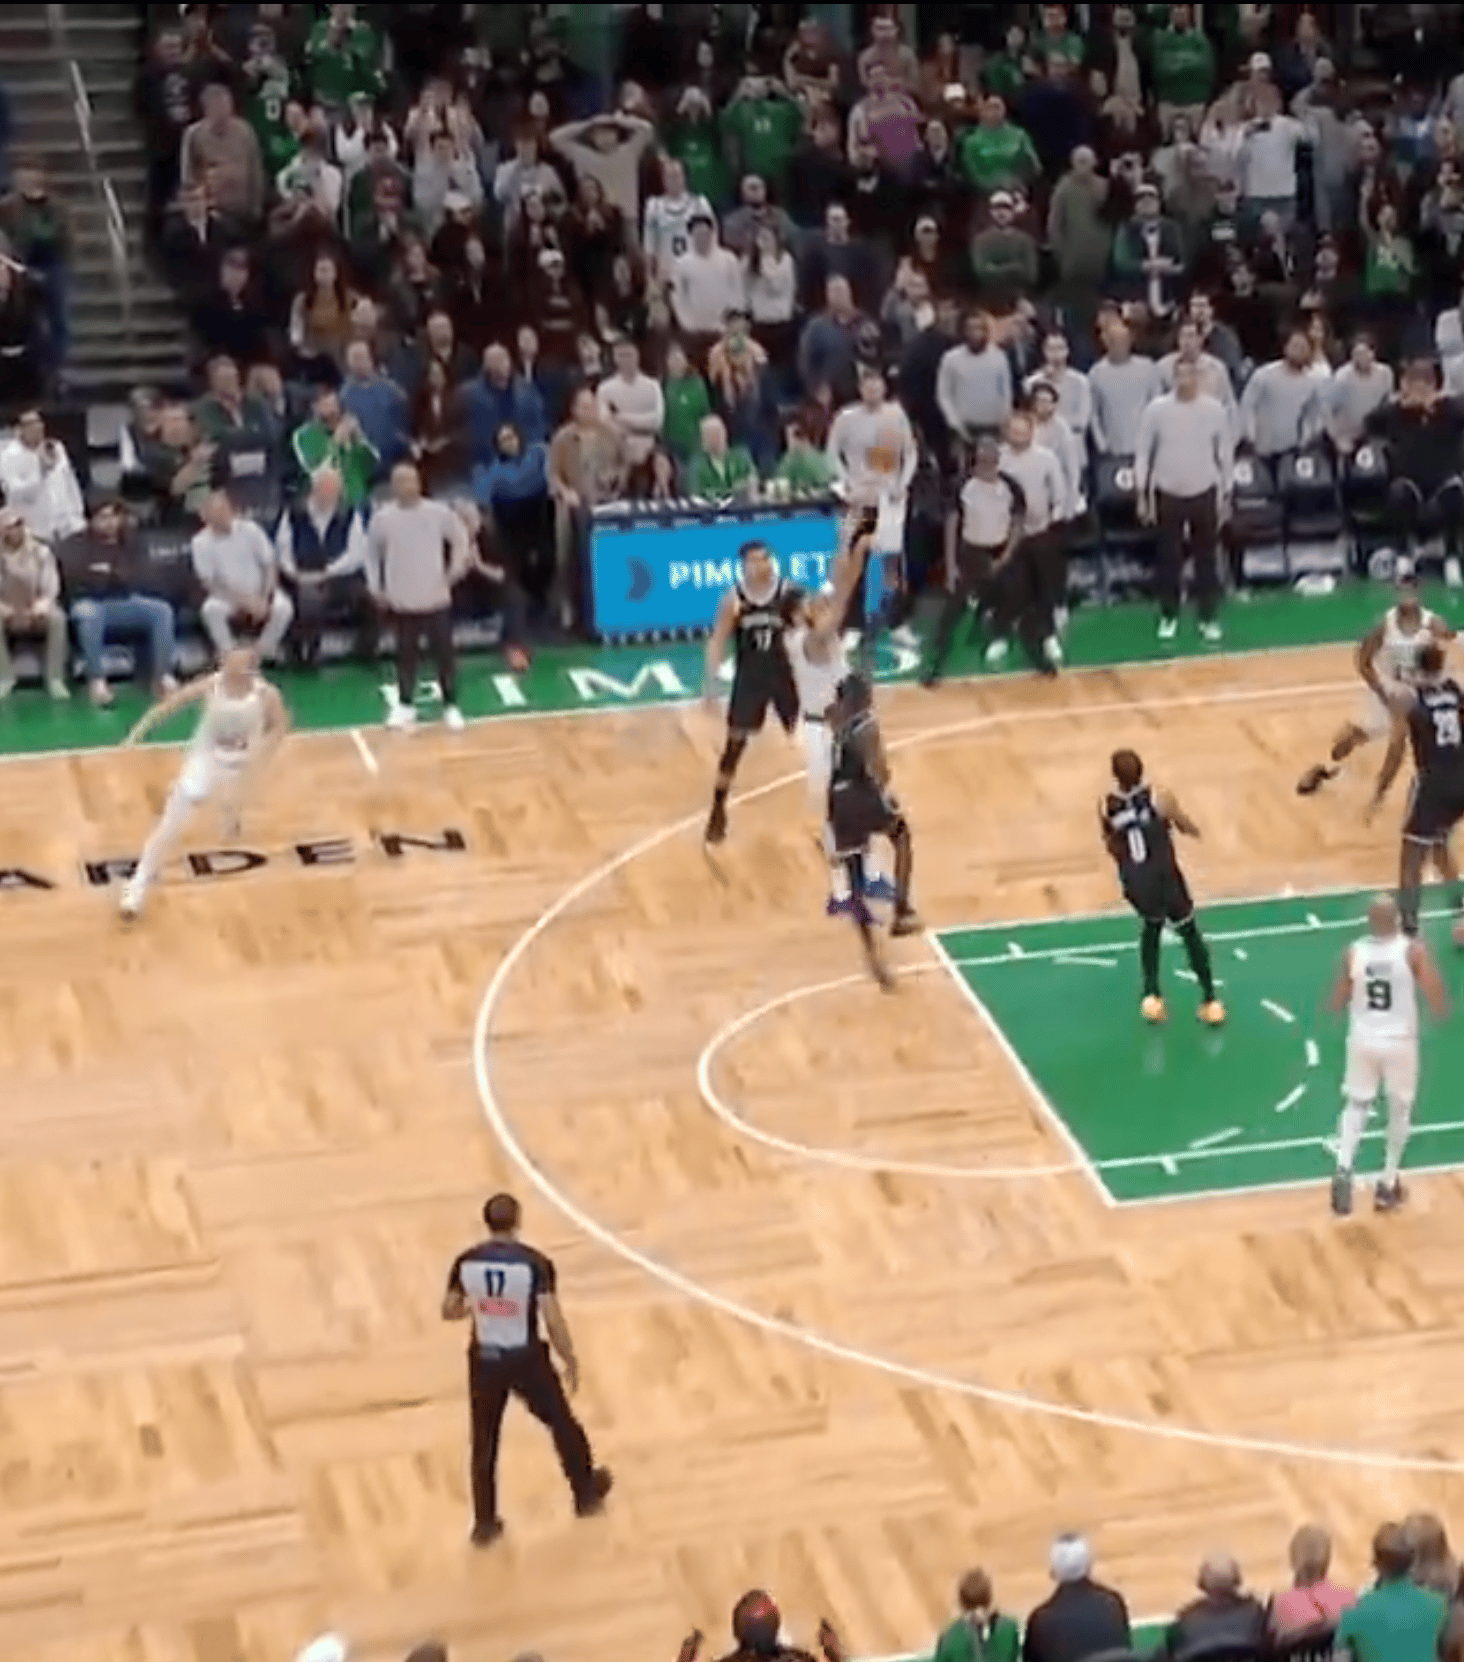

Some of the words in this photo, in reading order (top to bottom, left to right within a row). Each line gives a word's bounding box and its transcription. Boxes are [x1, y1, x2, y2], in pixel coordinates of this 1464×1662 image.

[668, 557, 782, 590] PIM
[1365, 978, 1393, 1013] 9
[484, 1267, 506, 1299] 17
